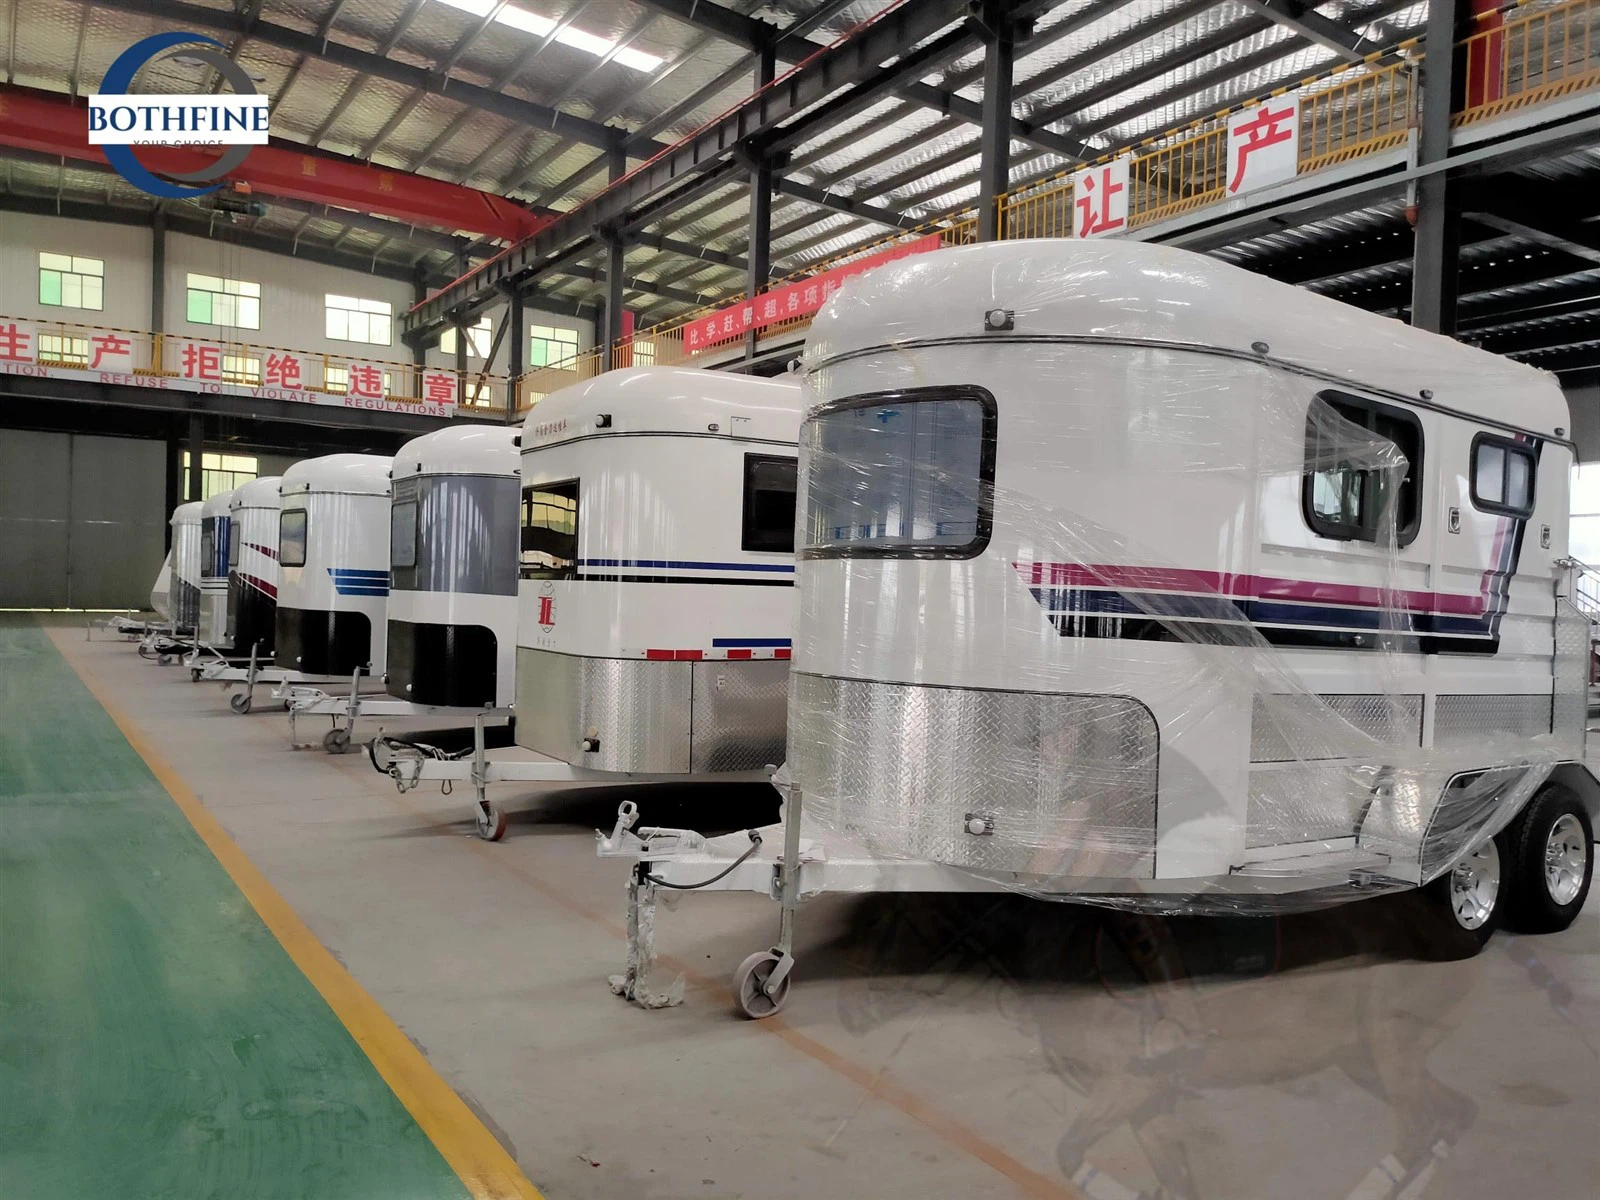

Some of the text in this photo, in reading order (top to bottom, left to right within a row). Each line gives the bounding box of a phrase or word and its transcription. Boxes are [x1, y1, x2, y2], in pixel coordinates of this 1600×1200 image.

[0, 323, 456, 407] 生产拒绝违章
[100, 373, 168, 389] REFUSE
[201, 382, 221, 394] TO
[251, 387, 317, 403] VIOLATE
